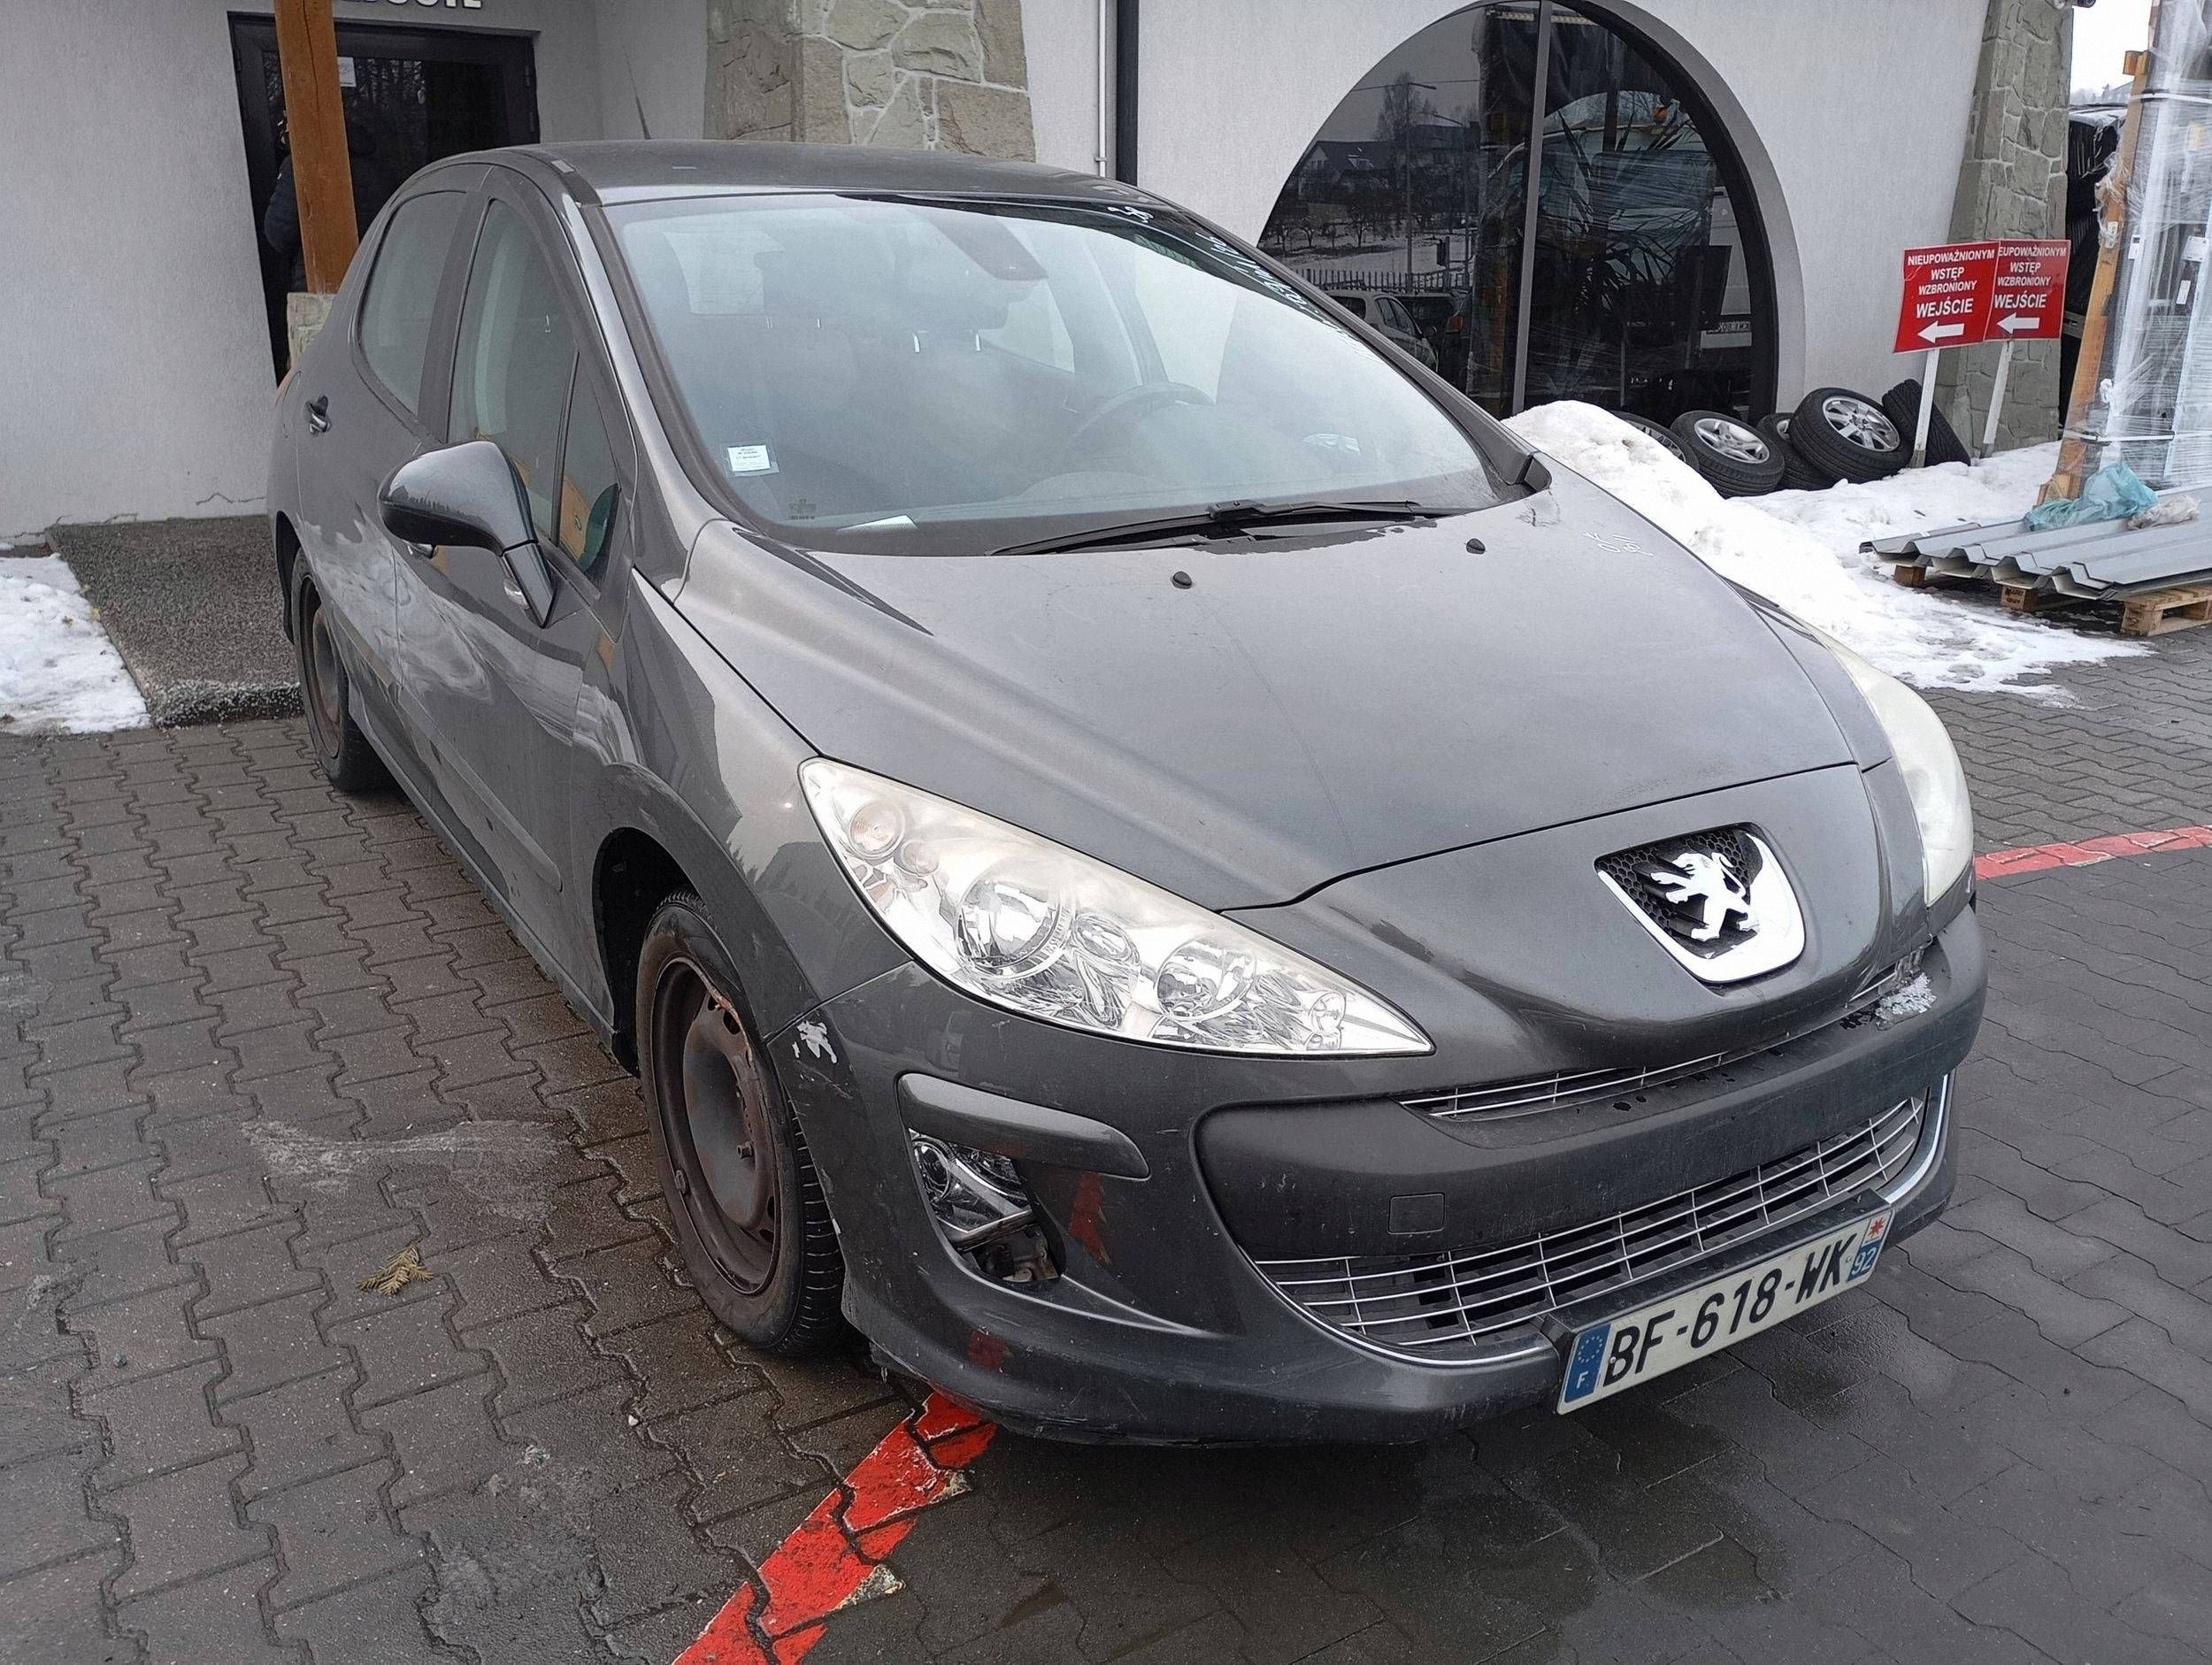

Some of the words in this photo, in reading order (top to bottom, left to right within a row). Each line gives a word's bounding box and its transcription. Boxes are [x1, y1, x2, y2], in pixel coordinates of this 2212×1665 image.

[1908, 249, 1995, 265] NIEUPOWAŻNIONYM
[1931, 266, 1964, 280] WSTĘP
[2010, 261, 2041, 275] WSTĘP
[1918, 280, 1978, 295] WZBRONIONY
[1997, 276, 2051, 287] WZBRONIONY
[1916, 296, 1974, 318] WEJŚCIE
[1994, 289, 2047, 308] WEJŚCIE
[1852, 1247, 1877, 1276] 92
[1603, 1232, 1857, 1387] BF-618-WK
[1576, 1370, 1589, 1390] F
